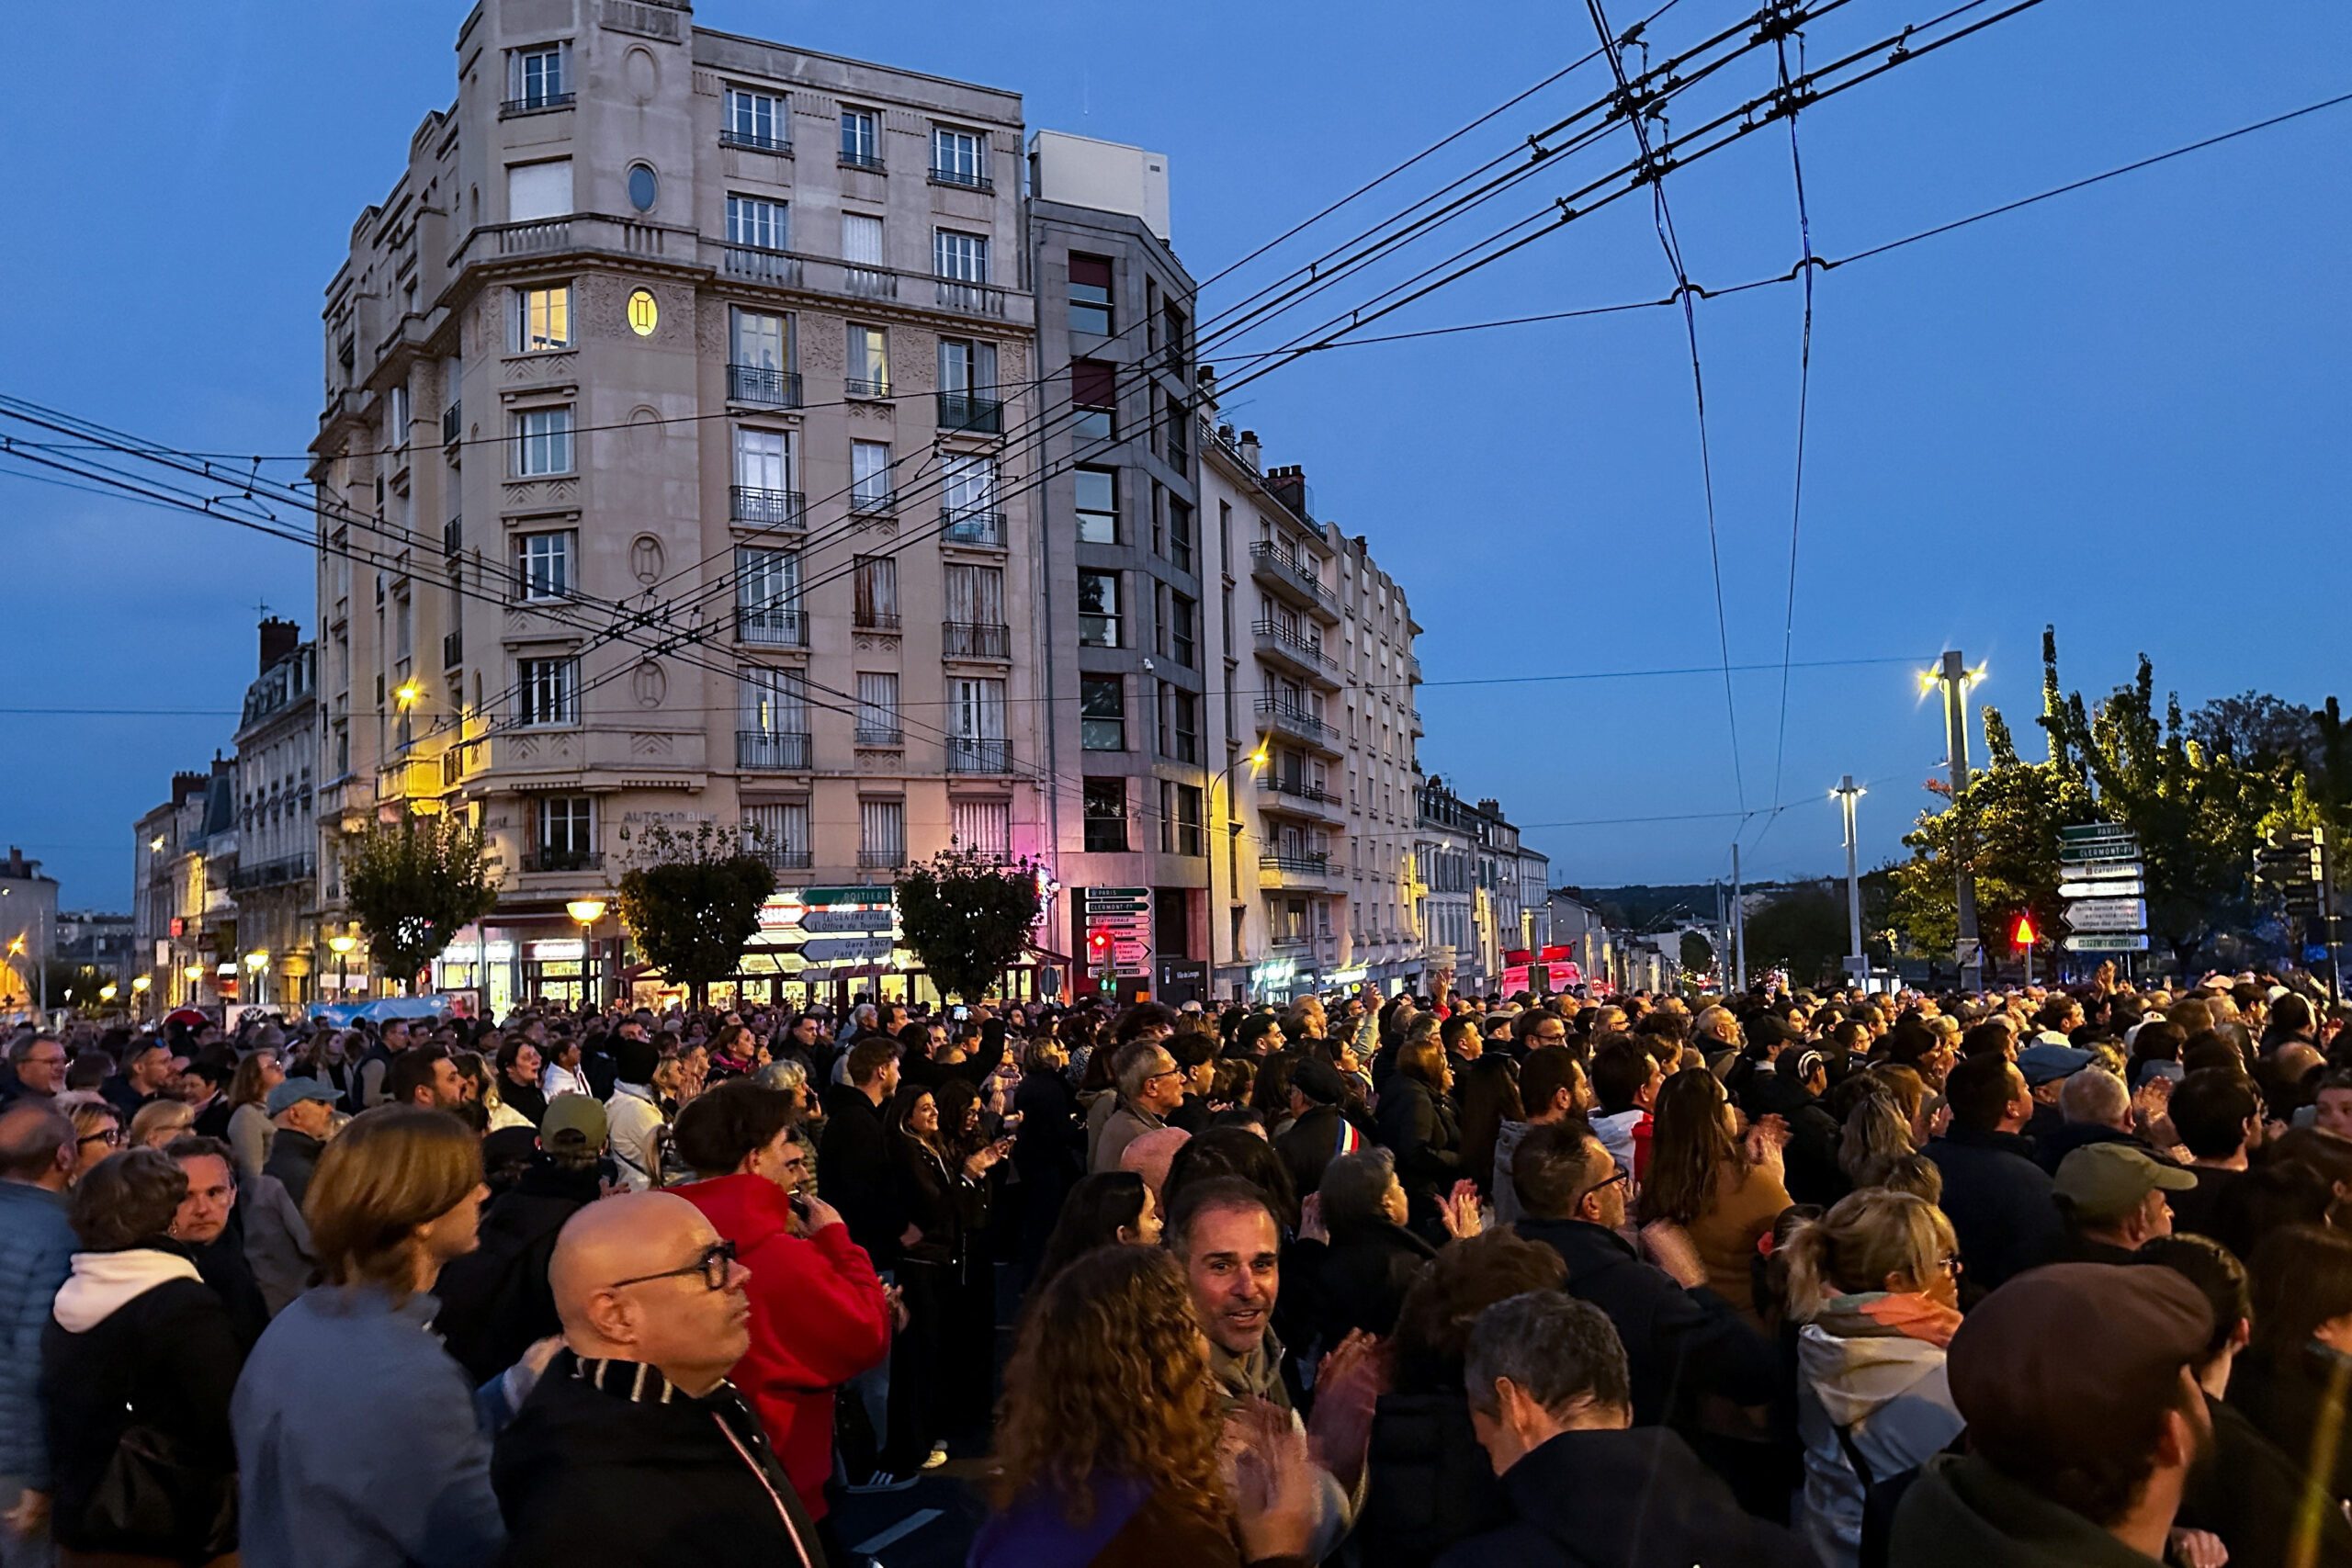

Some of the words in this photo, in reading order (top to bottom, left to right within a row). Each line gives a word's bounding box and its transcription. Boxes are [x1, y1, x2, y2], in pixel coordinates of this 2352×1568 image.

[2098, 827, 2120, 835] PARIS
[843, 892, 889, 901] POITIERS
[834, 911, 865, 920] CENTRE
[870, 911, 889, 920] VILLE
[869, 939, 889, 947] SNCF
